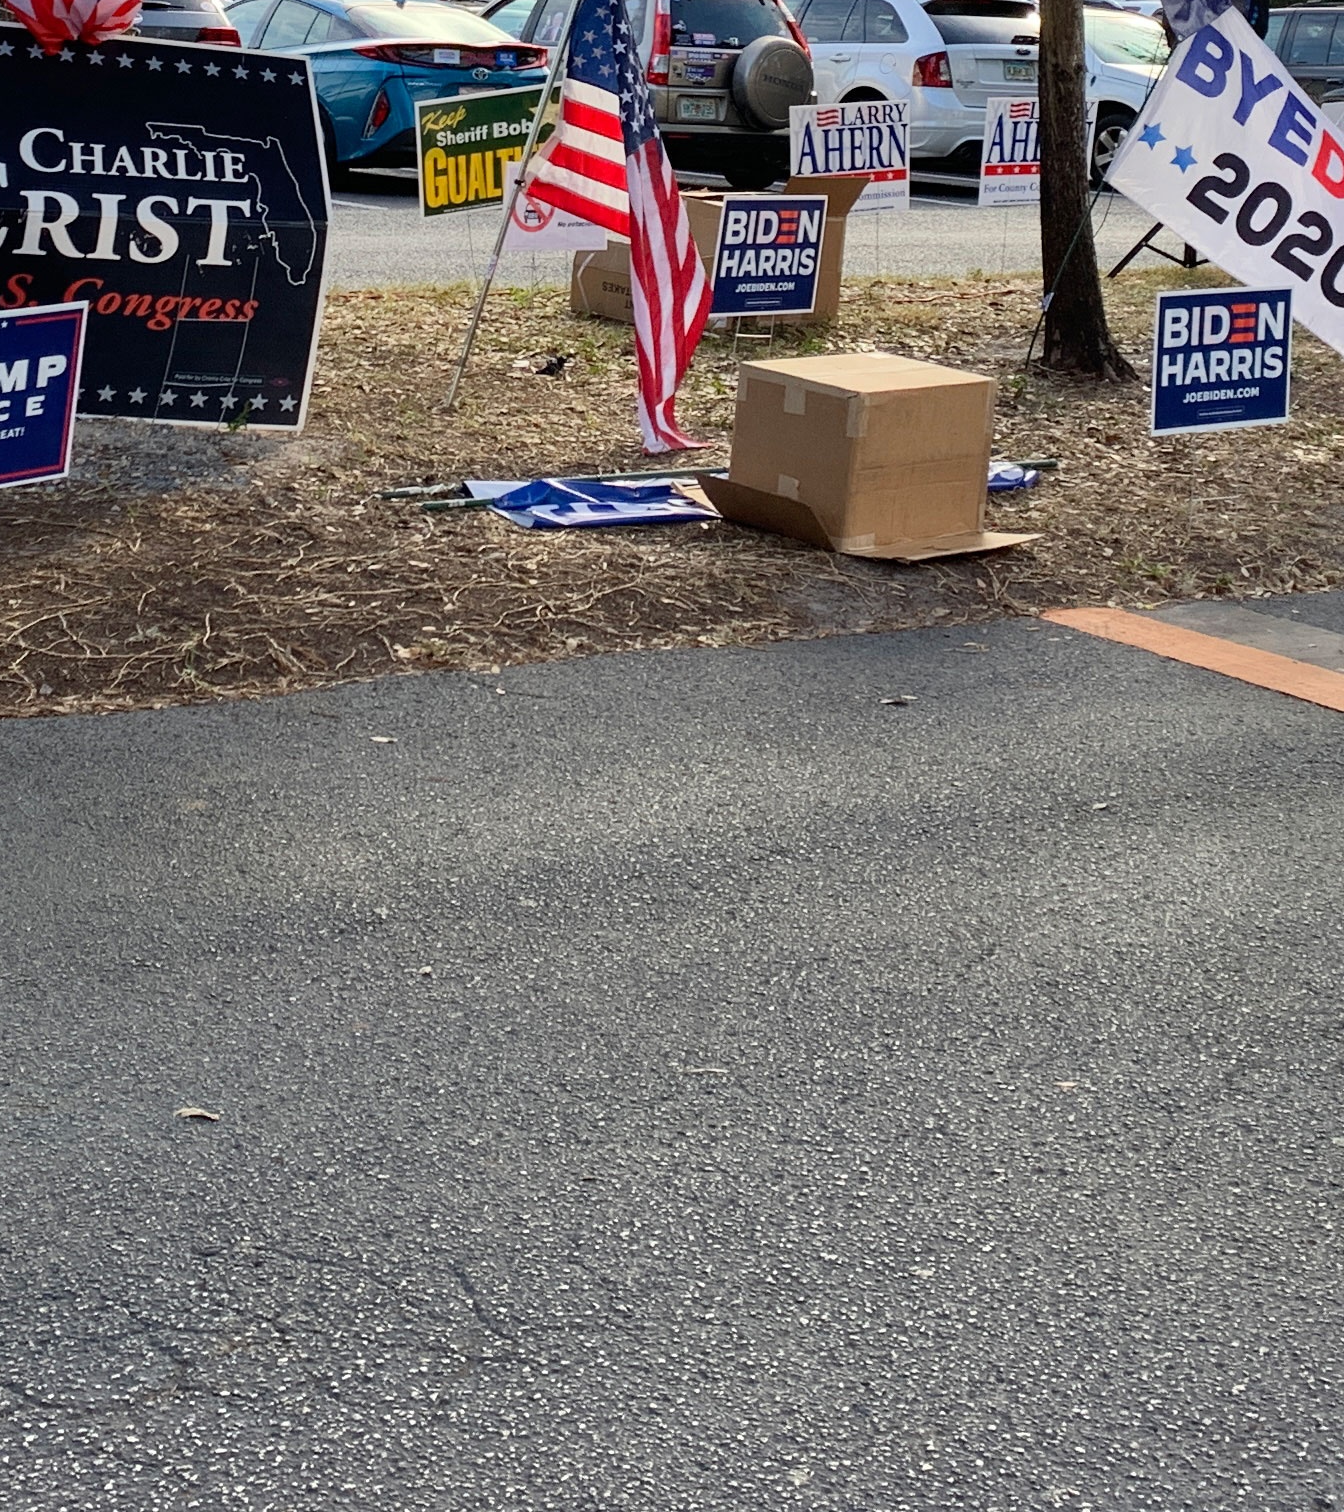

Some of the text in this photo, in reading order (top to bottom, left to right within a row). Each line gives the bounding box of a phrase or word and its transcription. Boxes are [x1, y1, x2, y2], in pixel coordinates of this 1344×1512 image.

[421, 105, 467, 136] Keep
[839, 102, 907, 126] LARRY
[436, 119, 532, 147] Sheriff Bob
[796, 120, 908, 176] AHERN
[19, 127, 250, 183] CHARLIE
[856, 190, 906, 202] ommission
[723, 209, 821, 245] BIDEN
[719, 247, 816, 278] HARRIS
[735, 281, 796, 293] JOEBIDEN.COM
[62, 277, 260, 331] Congress
[1162, 301, 1285, 349] BIDEN
[1160, 346, 1284, 387] HARRIS
[1182, 386, 1260, 404] JOEBIDEN.COM
